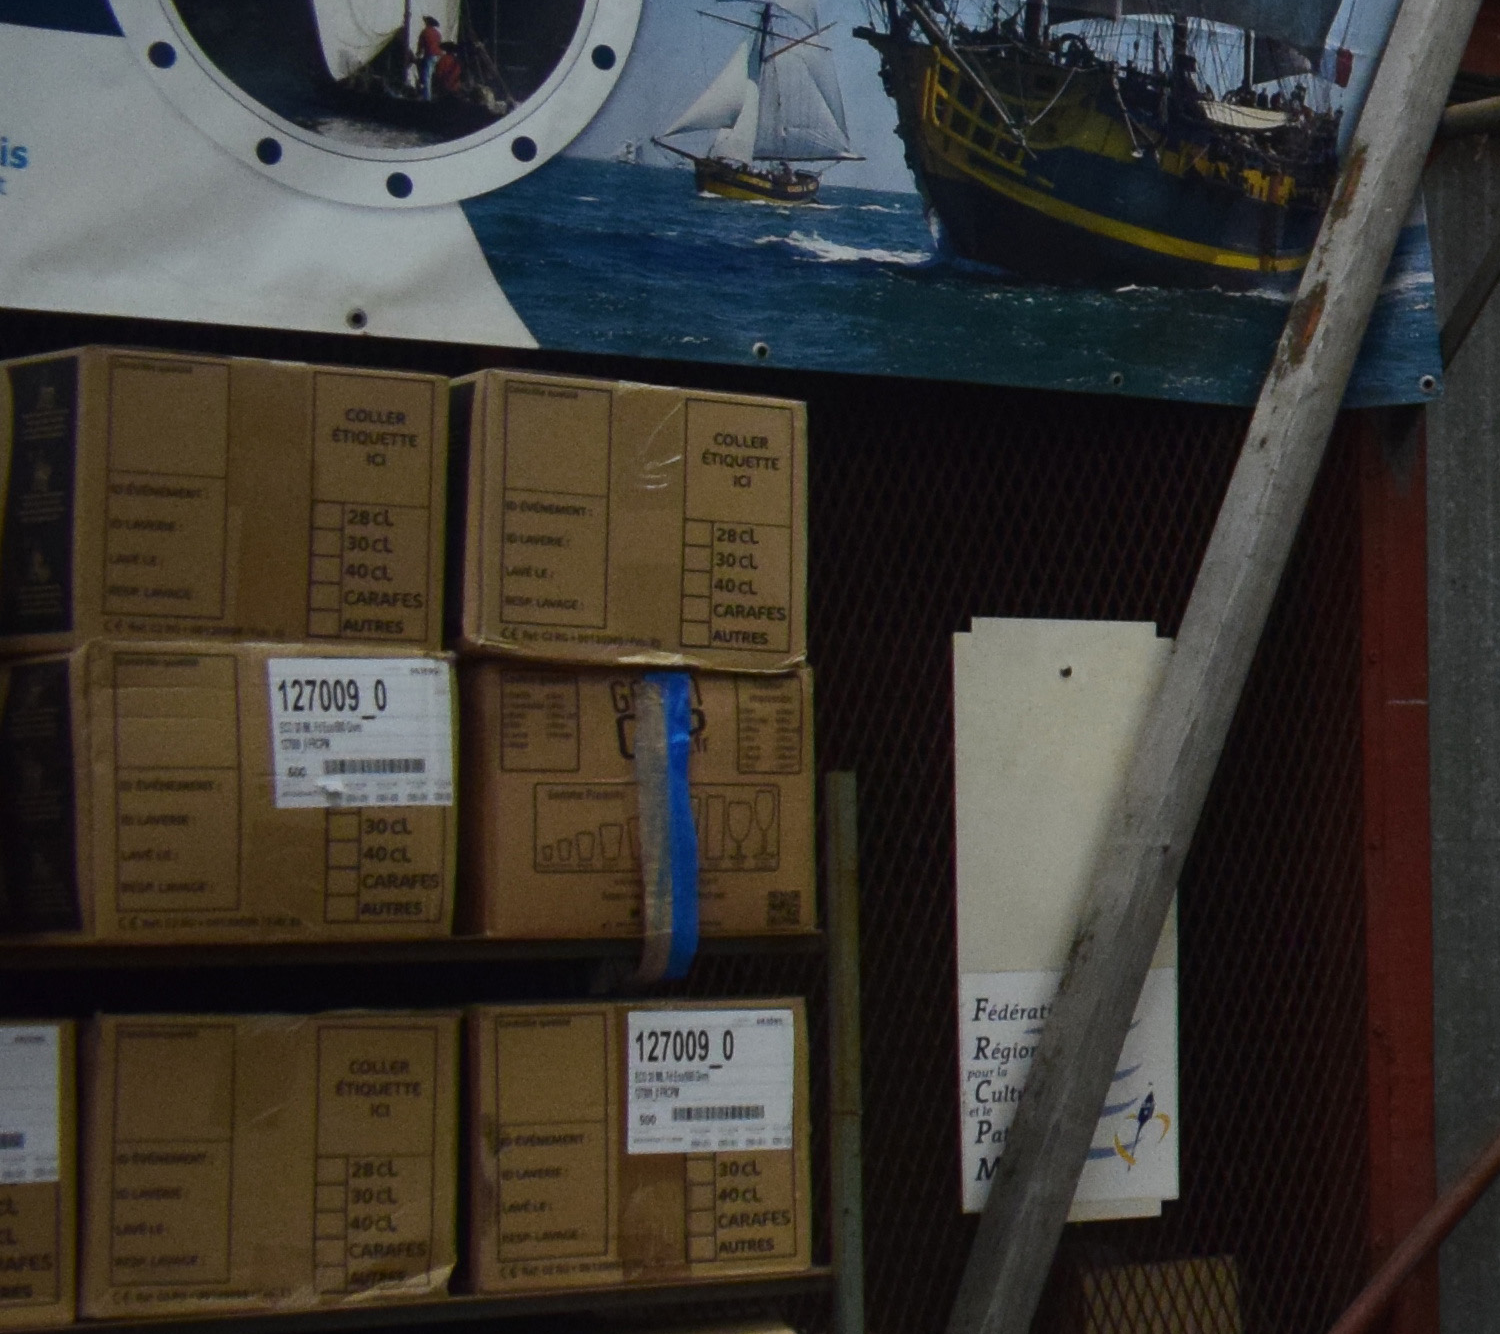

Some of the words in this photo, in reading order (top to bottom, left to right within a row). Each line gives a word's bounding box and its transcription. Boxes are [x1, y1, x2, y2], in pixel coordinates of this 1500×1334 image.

[345, 408, 406, 425] COLLER
[332, 426, 418, 447] ÉTIQUETTE
[714, 432, 768, 449] COLLER
[366, 452, 387, 466] ICI
[701, 450, 780, 471] ÉTIQUETTE
[733, 475, 752, 488] ICI
[347, 509, 370, 525] 28
[716, 528, 737, 543] 28
[346, 536, 369, 552] 30
[715, 553, 736, 567] 30
[345, 564, 368, 579] 40
[714, 578, 736, 593] 40
[344, 590, 424, 609] CARAFES
[713, 603, 787, 621] CARAFES
[343, 618, 404, 634] AUTRES
[712, 629, 768, 645] AUTRES
[278, 679, 387, 720] 127009_0
[364, 818, 389, 835] 30
[363, 846, 388, 862] 40
[362, 873, 439, 891] CARAFES
[361, 901, 423, 917] AUTRES
[636, 1029, 734, 1069] 127009_0
[350, 1059, 410, 1075] COLLER
[967, 1069, 993, 1081] pour
[997, 1067, 1007, 1077] la
[335, 1079, 422, 1097] ÉTIQUETTE
[371, 1103, 391, 1118] ICI
[969, 1106, 979, 1118] et
[983, 1106, 993, 1117] le
[352, 1162, 374, 1178] 28
[719, 1162, 741, 1178] 30
[351, 1188, 374, 1205] 30
[718, 1188, 740, 1204] 40
[350, 1215, 374, 1231] 40
[717, 1211, 791, 1229] CARAFES
[349, 1241, 427, 1259] CARAFES
[718, 1237, 775, 1254] AUTRES
